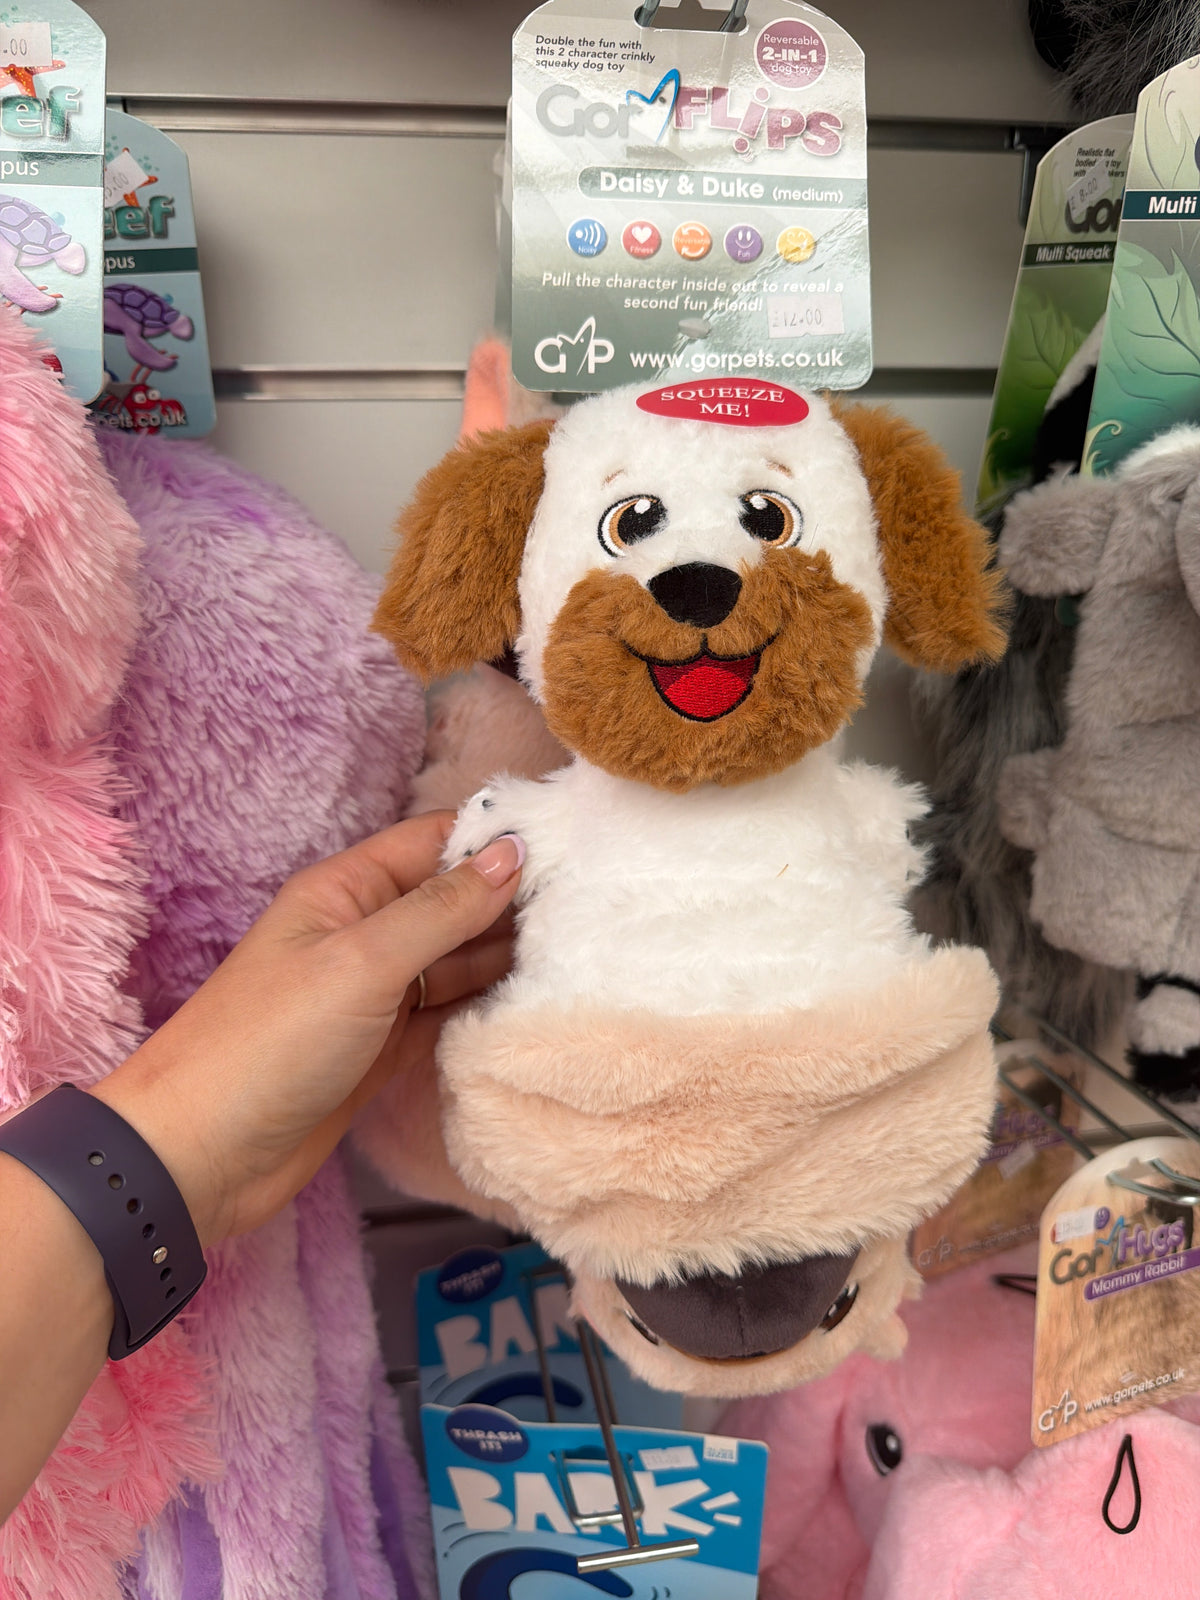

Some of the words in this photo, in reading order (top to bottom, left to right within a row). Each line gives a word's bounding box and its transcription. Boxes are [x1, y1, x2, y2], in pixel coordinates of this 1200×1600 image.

[536, 34, 574, 46] Double
[578, 37, 596, 48] the
[599, 38, 616, 48] fun
[619, 40, 642, 50] with
[763, 33, 819, 46] Reversable
[536, 46, 555, 56] this
[558, 47, 565, 57] 2
[568, 48, 618, 60] character
[621, 51, 656, 64] crinkly
[761, 46, 818, 63] 2-IN-1
[535, 59, 580, 71] squeaky
[582, 60, 604, 72] dog
[608, 62, 625, 73] toy
[771, 63, 792, 75] dog
[794, 65, 812, 76] toy
[600, 171, 668, 198] Daisy
[677, 174, 694, 196] &
[702, 175, 765, 199] Duke
[772, 188, 844, 204] (medium)
[1147, 195, 1198, 214] Multi
[1036, 246, 1064, 263] Multi
[1065, 244, 1111, 264] Squeak
[541, 271, 571, 287] Pull
[575, 272, 601, 288] the
[605, 272, 678, 290] character
[682, 277, 727, 293] inside
[731, 280, 758, 295] out
[763, 280, 778, 293] to
[783, 278, 830, 293] reveal
[834, 283, 844, 293] a
[623, 295, 679, 310] second
[683, 296, 708, 311] fun
[712, 297, 763, 312] friend!
[629, 349, 844, 373] www.gorpets.co.uk
[660, 387, 786, 404] SQUEEZE
[700, 402, 750, 418] ME!
[1117, 1217, 1186, 1263] Hugs
[1091, 1271, 1142, 1296] Mommy
[1144, 1256, 1186, 1278] Rabbit
[1083, 1366, 1186, 1414] www.gorpets.co.uk
[446, 1465, 716, 1537] BARK
